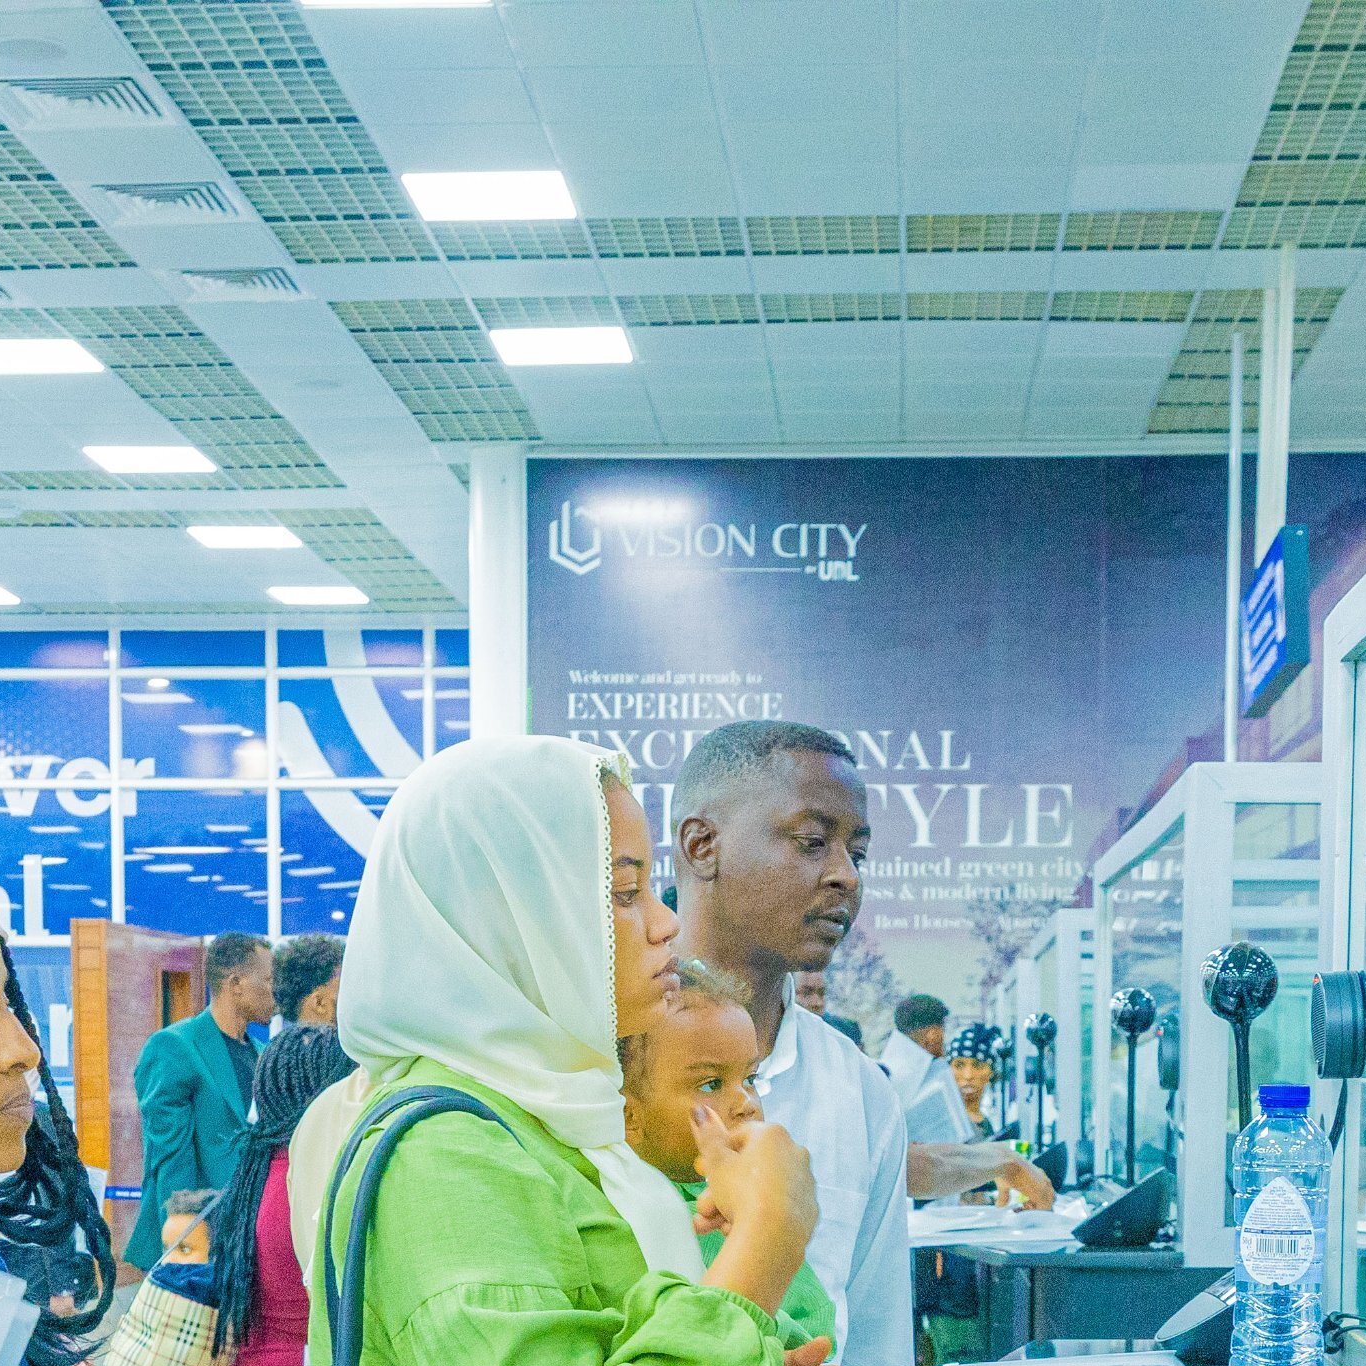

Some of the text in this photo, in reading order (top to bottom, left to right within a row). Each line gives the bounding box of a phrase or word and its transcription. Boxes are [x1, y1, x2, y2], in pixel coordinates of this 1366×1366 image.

[617, 523, 868, 559] VISION CITY
[568, 669, 764, 687] Welcome and get ready to
[566, 691, 784, 720] EXPERIENCE
[958, 860, 1037, 881] green
[921, 882, 1010, 900] modern
